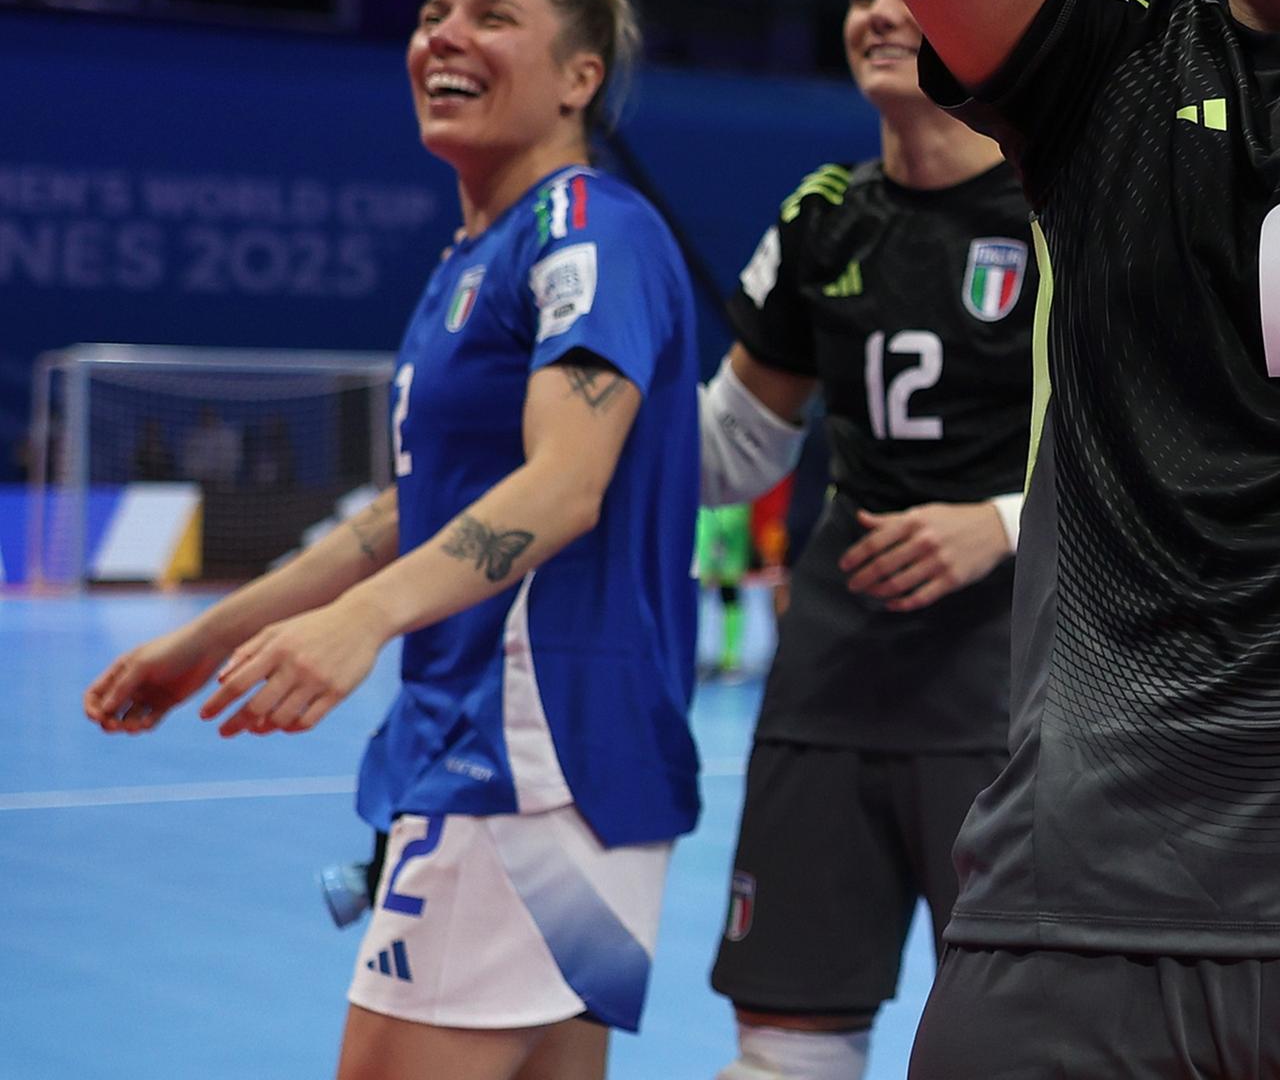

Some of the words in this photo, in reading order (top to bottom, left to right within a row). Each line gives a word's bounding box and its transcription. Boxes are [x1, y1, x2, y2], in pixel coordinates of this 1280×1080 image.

[143, 175, 328, 224] WORLD
[185, 226, 377, 297] 2025
[864, 329, 944, 440] 12
[383, 816, 445, 916] 2
